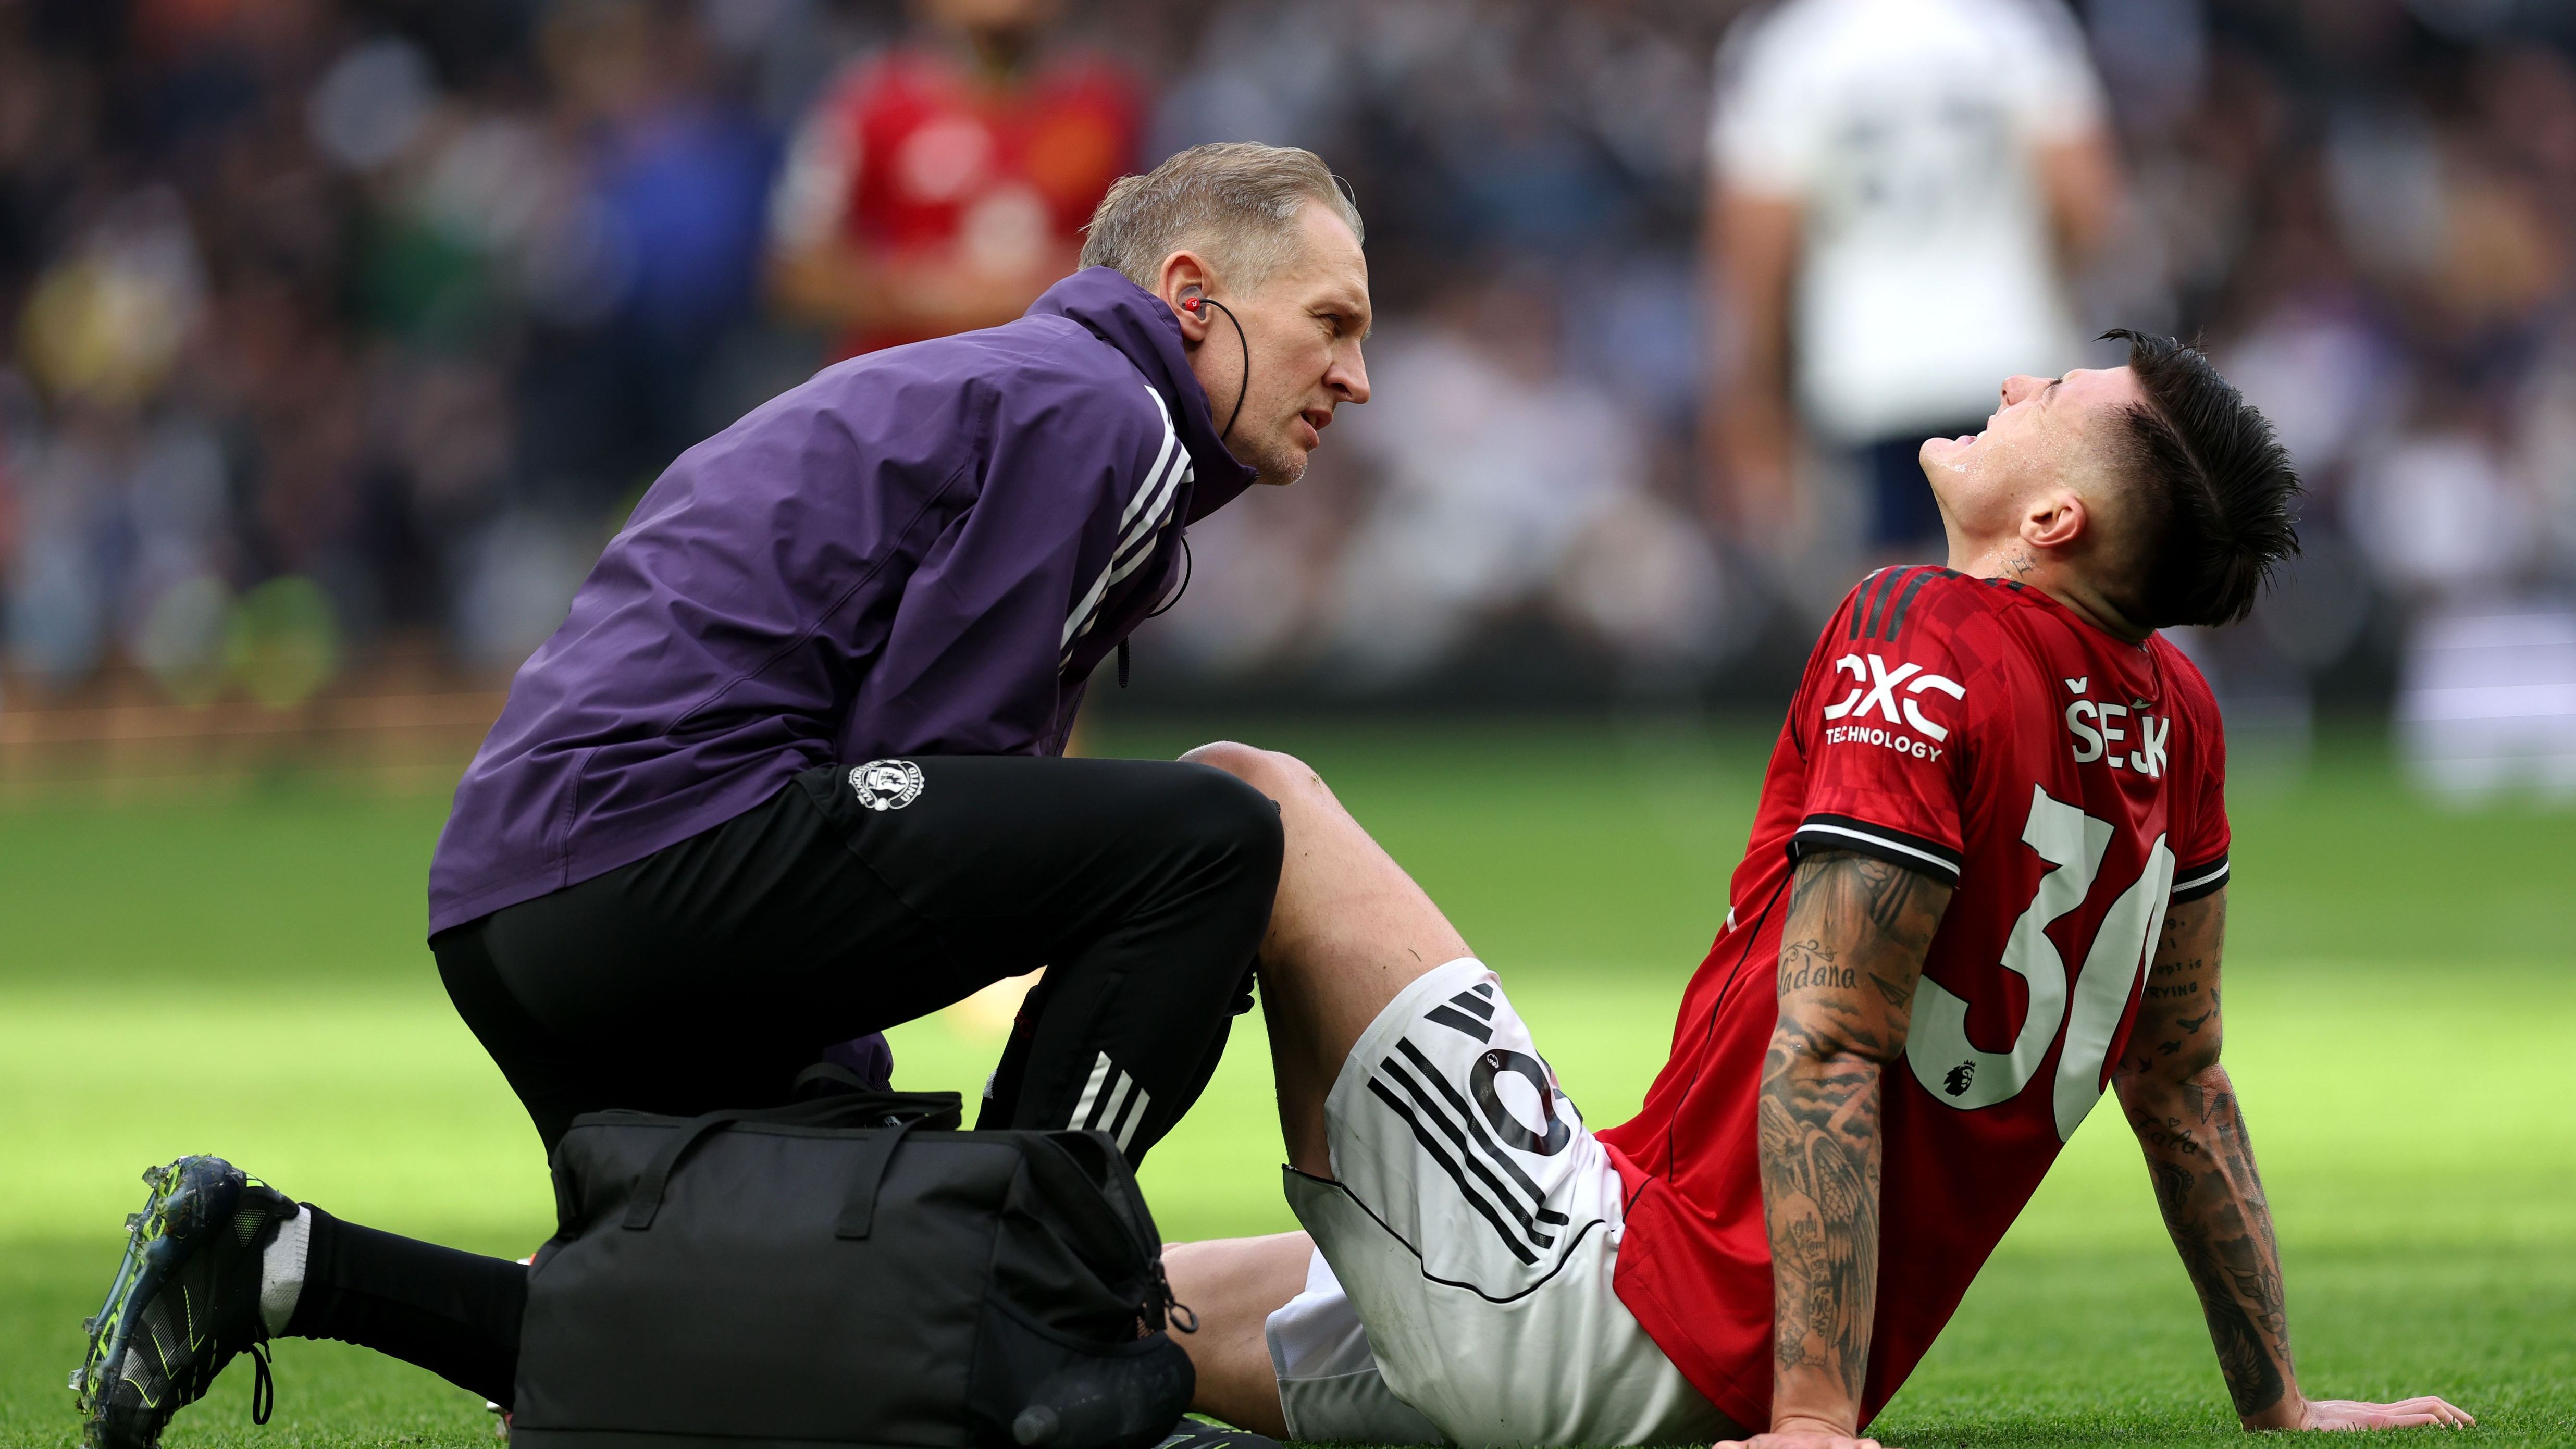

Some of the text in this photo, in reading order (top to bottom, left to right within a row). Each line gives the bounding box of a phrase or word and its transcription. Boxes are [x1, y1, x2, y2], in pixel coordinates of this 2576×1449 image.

[1824, 653, 1966, 743] DXC
[1826, 725, 1943, 762] TECHNOLOGY
[900, 766, 919, 802] UNITED
[1905, 782, 2176, 1143] 30
[2152, 962, 2182, 976] ept
[2145, 981, 2197, 999] RYING
